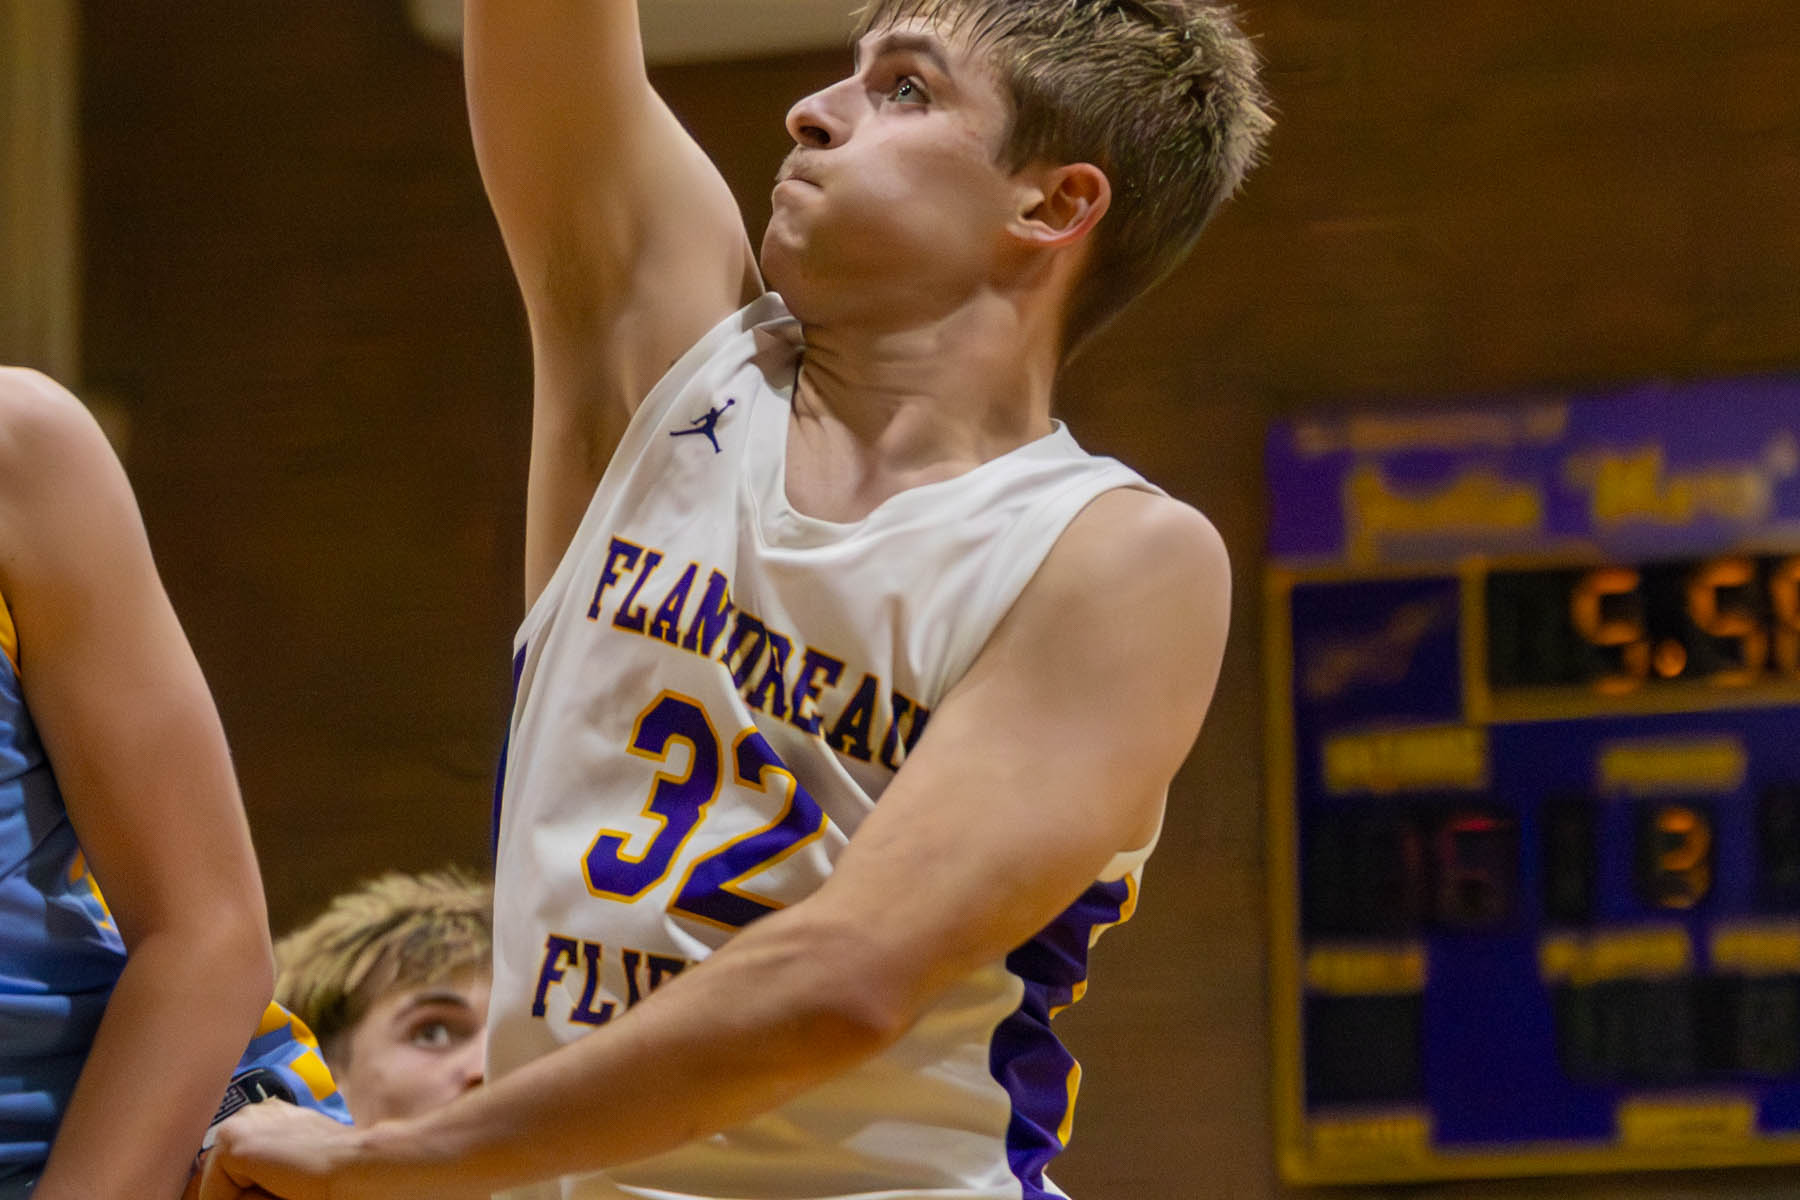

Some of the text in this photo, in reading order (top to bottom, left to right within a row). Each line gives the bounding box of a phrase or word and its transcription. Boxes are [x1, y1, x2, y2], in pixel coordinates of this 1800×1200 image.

[586, 535, 931, 774] FLANDREAU
[580, 689, 830, 932] 32
[1655, 804, 1712, 910] 3
